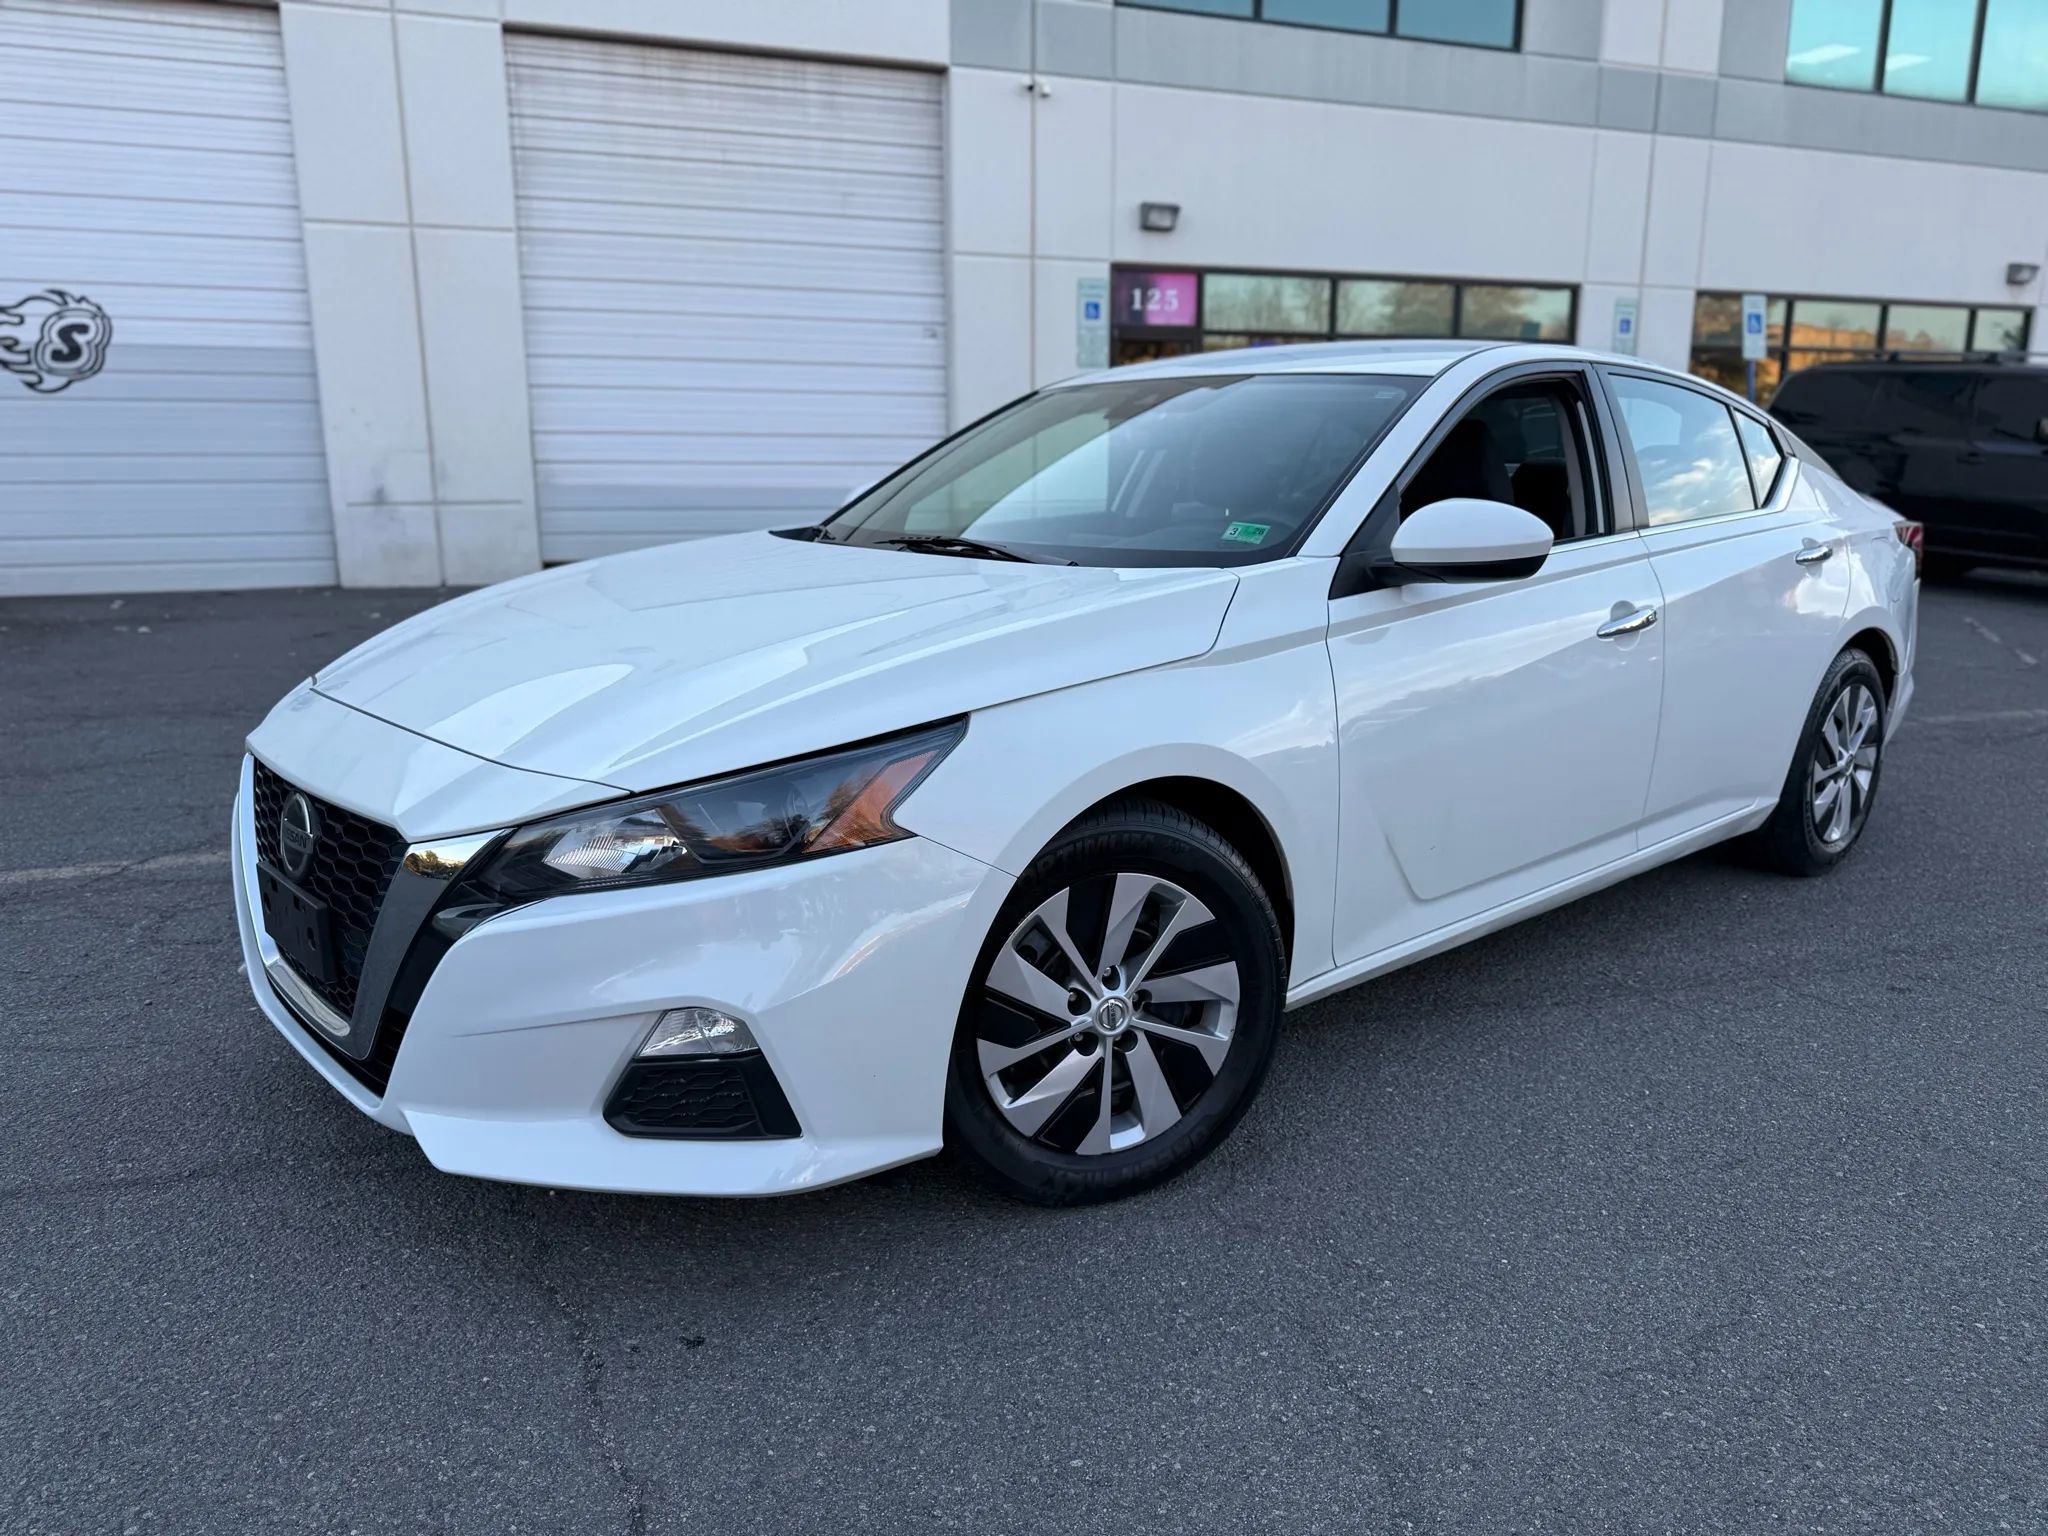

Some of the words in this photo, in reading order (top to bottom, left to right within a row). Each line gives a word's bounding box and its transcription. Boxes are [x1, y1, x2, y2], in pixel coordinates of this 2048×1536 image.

[1131, 287, 1179, 312] 125
[50, 323, 91, 363] S
[1229, 527, 1239, 536] 3
